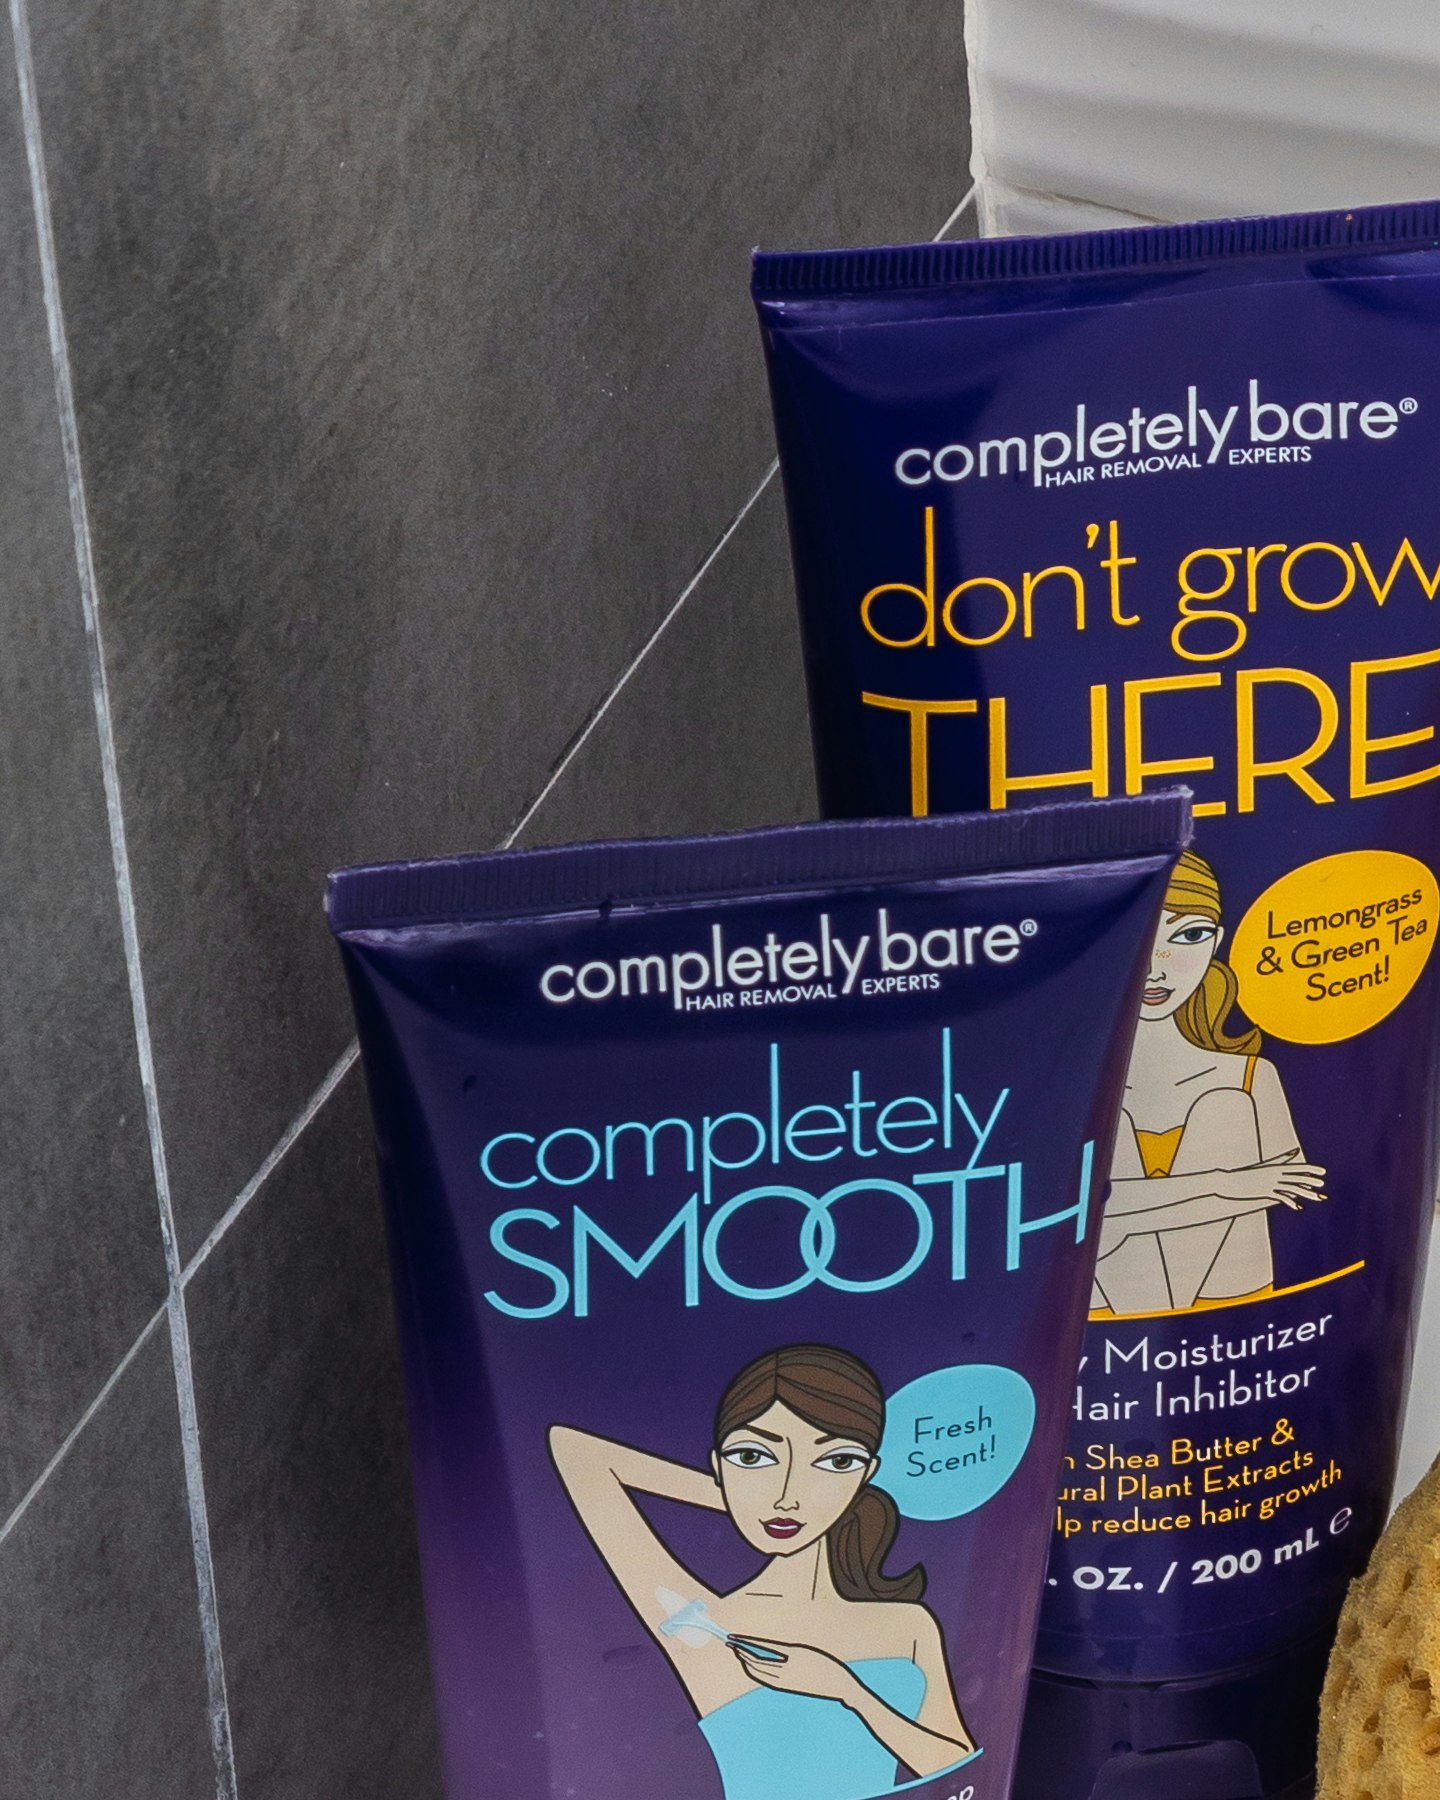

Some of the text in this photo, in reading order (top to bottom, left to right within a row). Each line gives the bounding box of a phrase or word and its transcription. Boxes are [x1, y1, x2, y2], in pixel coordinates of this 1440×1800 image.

[1045, 446, 1312, 488] HAIR REMOVAL EXPERTS
[1266, 889, 1423, 940] Lemongrass
[1255, 916, 1428, 976] & Green Tea
[685, 973, 941, 1012] HAIR REMOVAL EXPERTS
[1305, 956, 1391, 1002] Scent!
[480, 1027, 1009, 1204] completely
[482, 1140, 1094, 1320] SMOOTH
[1105, 1314, 1333, 1374] Moisturizer
[1156, 1366, 1317, 1417] Inhibitor
[914, 1406, 993, 1444] Fresh
[1085, 1443, 1160, 1470] Shea
[1171, 1436, 1263, 1466] Butter
[1271, 1418, 1295, 1445] &
[906, 1435, 997, 1478] Scent!
[1117, 1473, 1194, 1501] Plant
[1204, 1450, 1314, 1493] Extracts
[1091, 1505, 1192, 1534] reduce
[1201, 1499, 1252, 1525] hair
[1258, 1459, 1342, 1520] growth
[1072, 1565, 1144, 1591] OZ.
[1156, 1561, 1179, 1594] /
[1191, 1549, 1263, 1585] 200
[1273, 1527, 1320, 1565] mL
